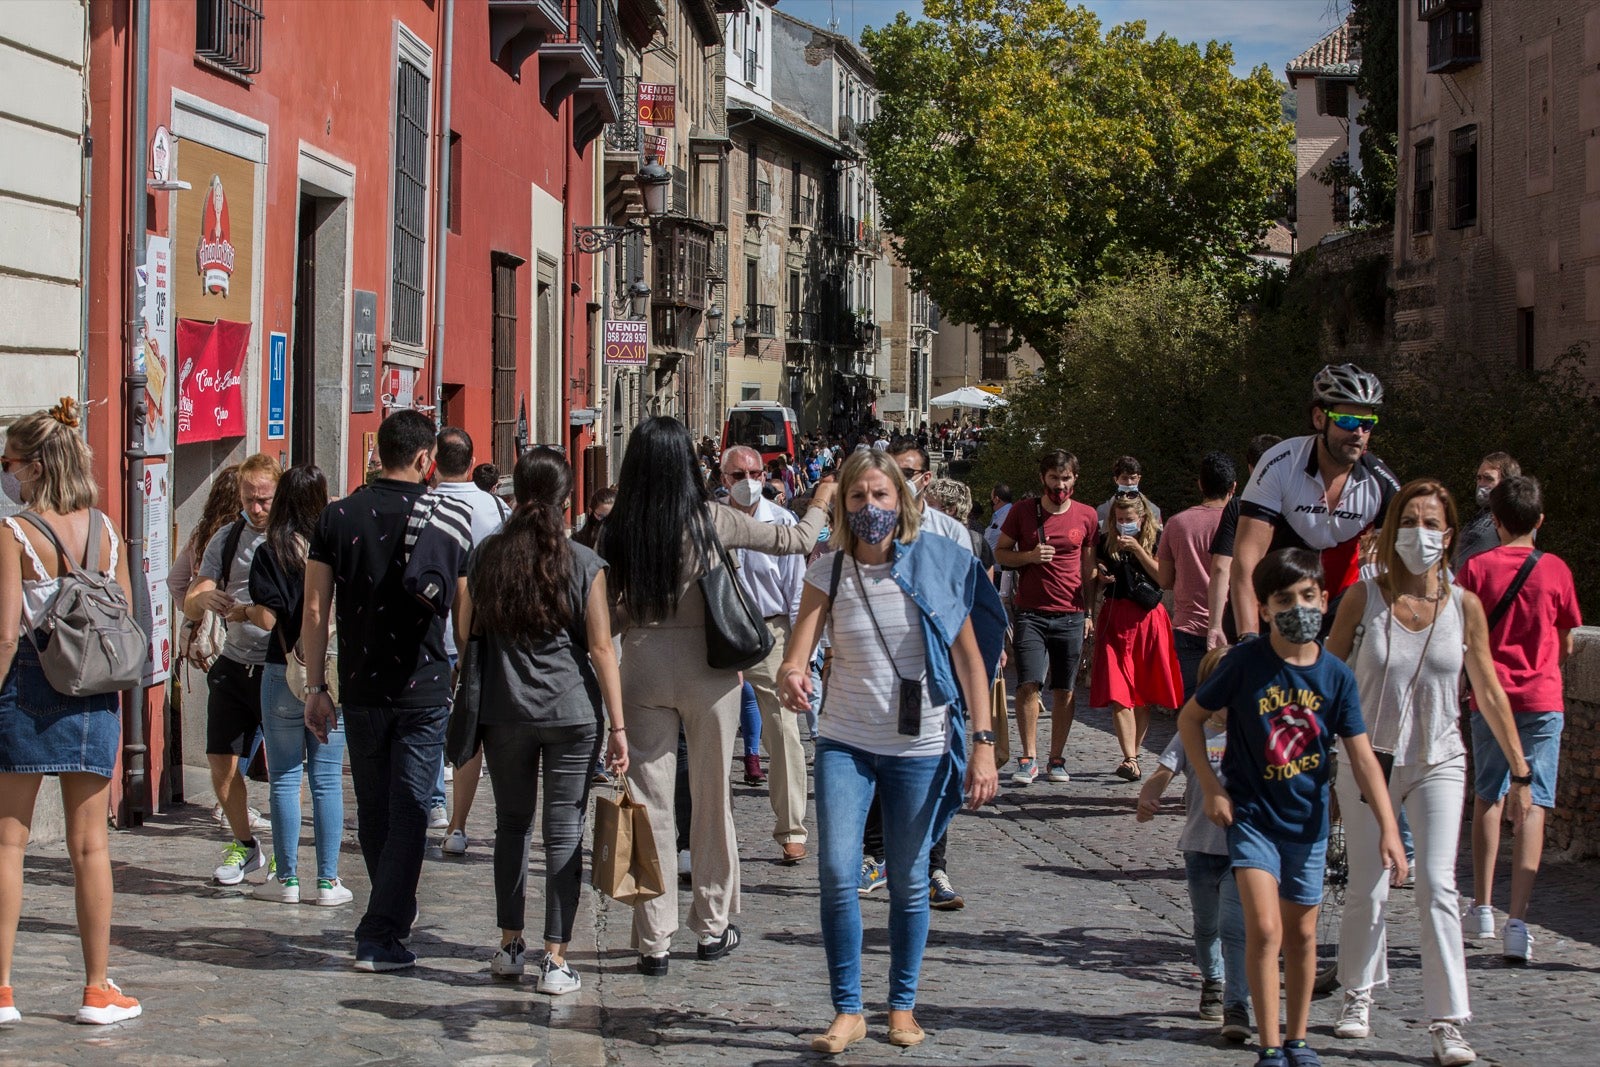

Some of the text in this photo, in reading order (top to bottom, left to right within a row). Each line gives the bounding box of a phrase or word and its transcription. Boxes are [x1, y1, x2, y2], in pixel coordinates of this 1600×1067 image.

[640, 85, 675, 95] VENDE
[607, 323, 647, 332] VENDE
[607, 332, 647, 343] 958 228 930
[1256, 449, 1291, 486] MERIDA
[1373, 465, 1401, 492] MERI
[1266, 685, 1280, 696] THE
[1258, 688, 1323, 715] ROLLING
[1263, 753, 1320, 780] STONES
